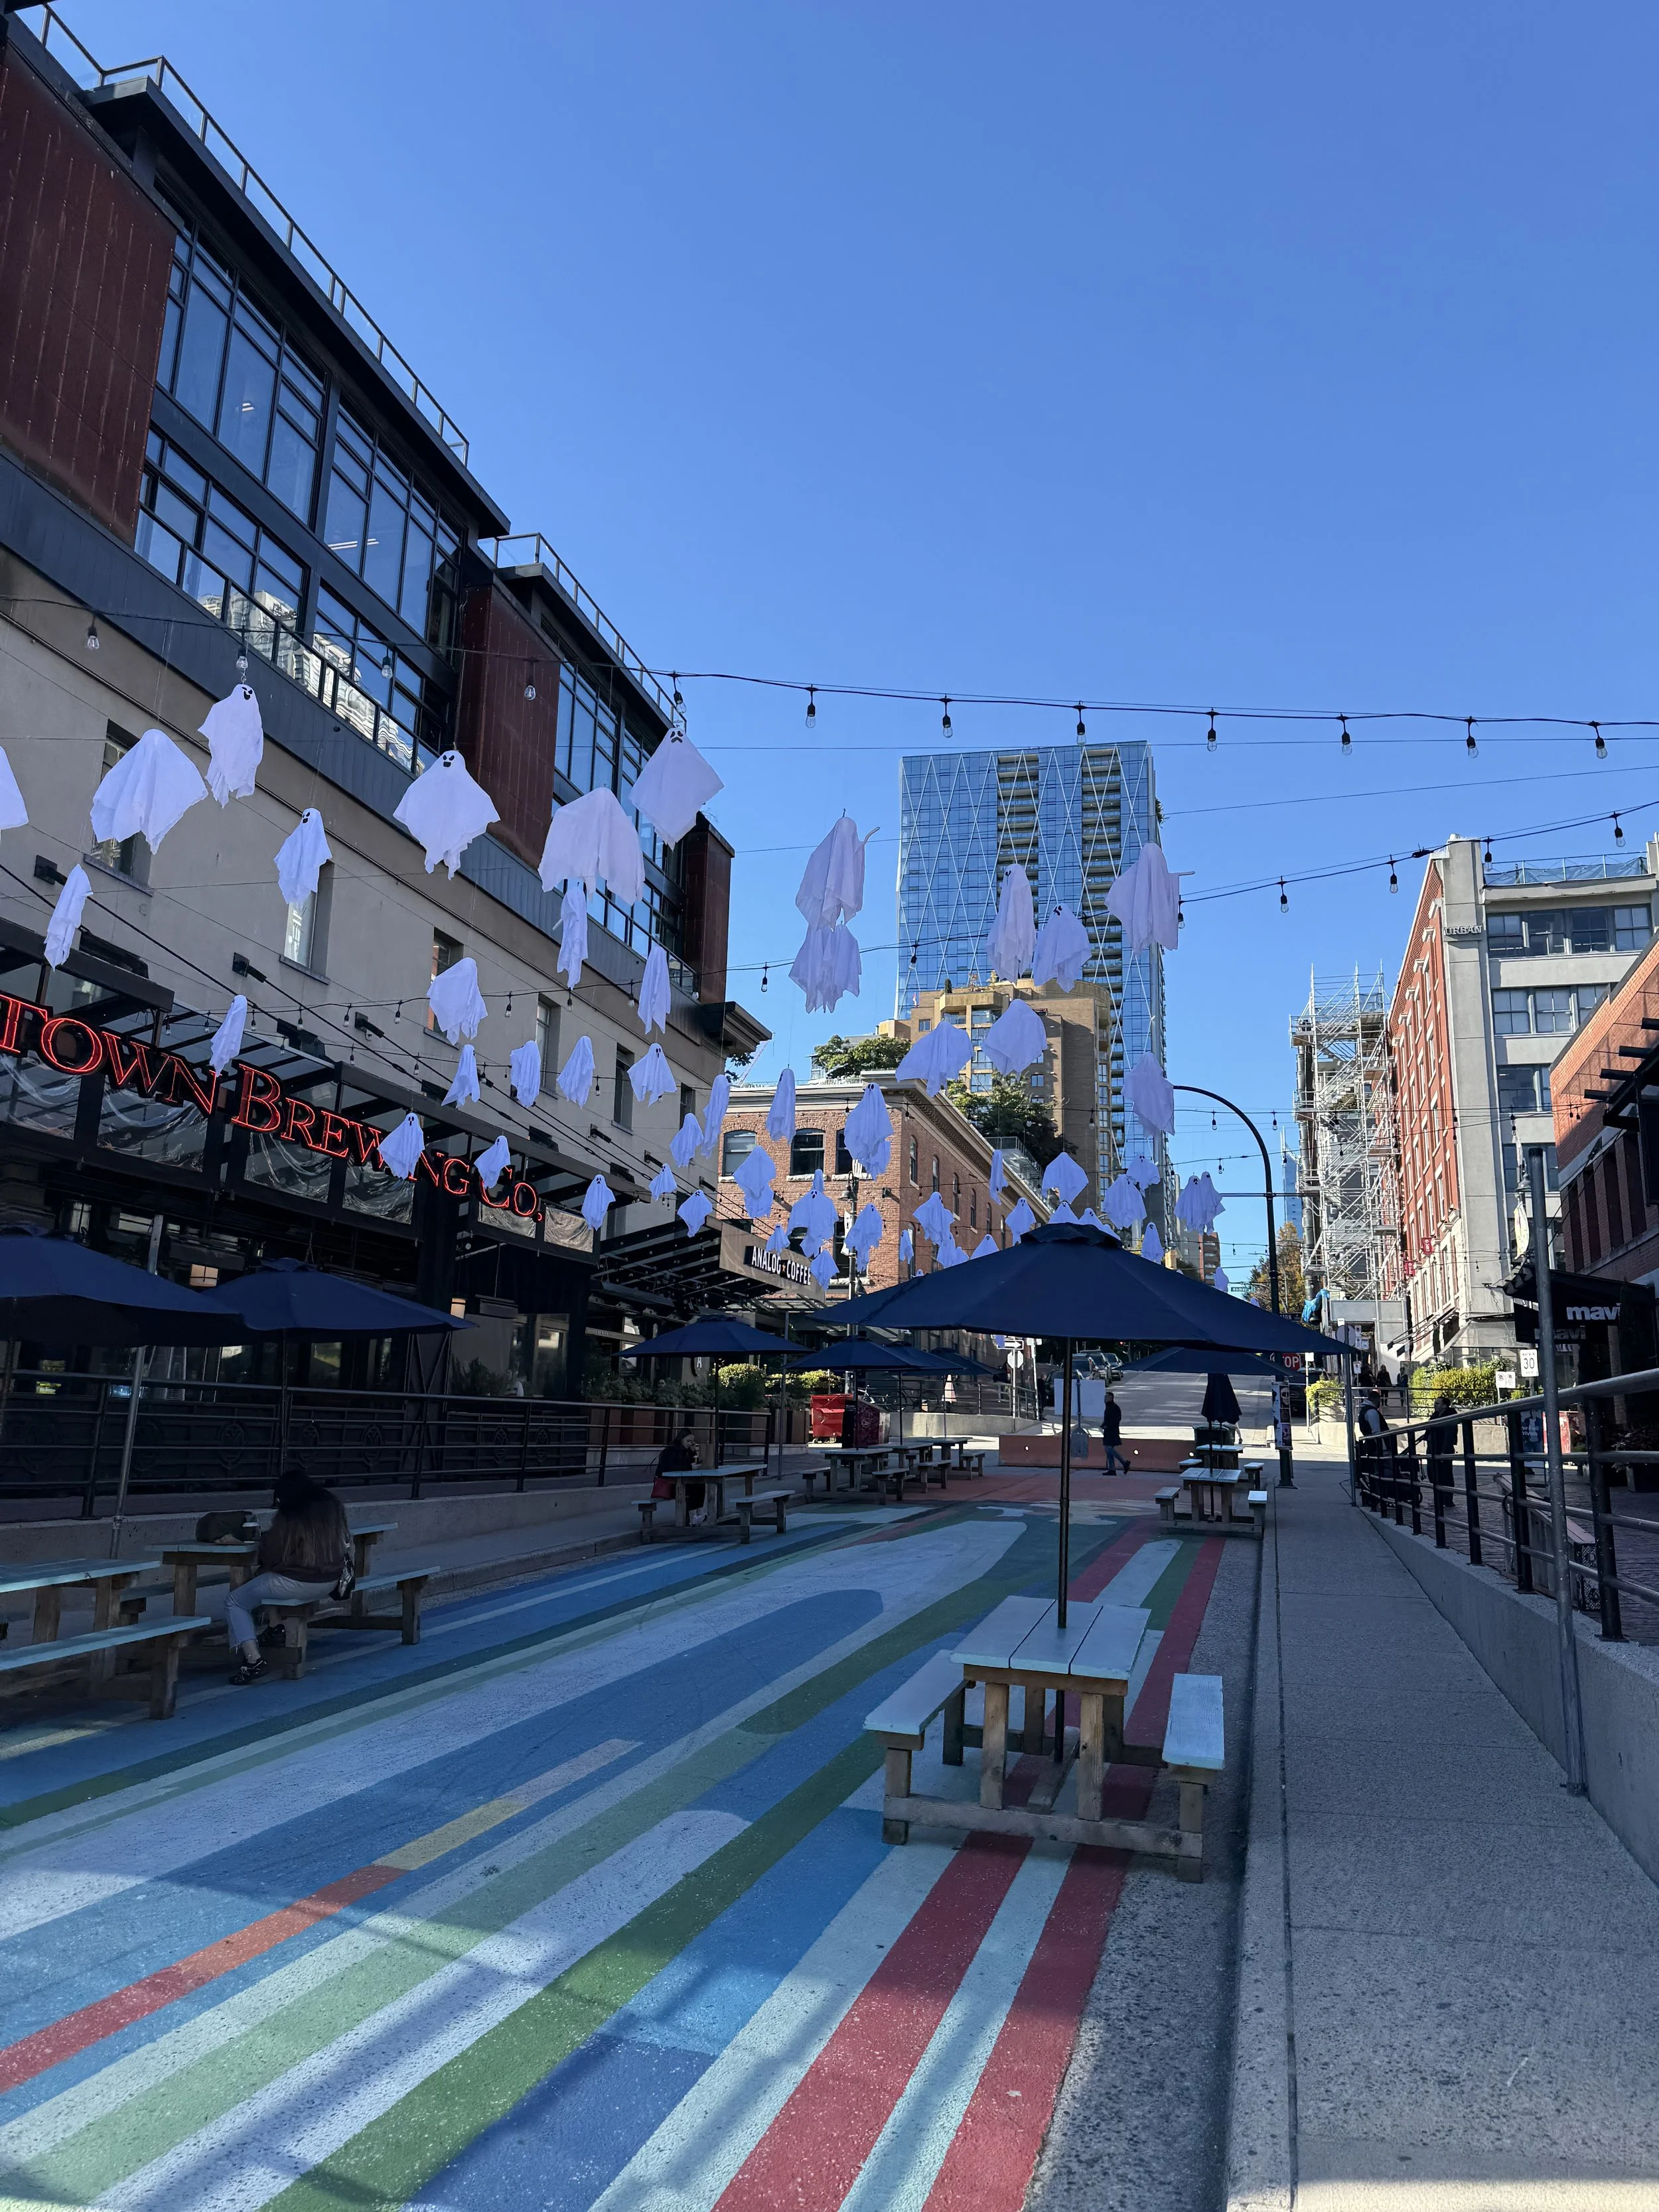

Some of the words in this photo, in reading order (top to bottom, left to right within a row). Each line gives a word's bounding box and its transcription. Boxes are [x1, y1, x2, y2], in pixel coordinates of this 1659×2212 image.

[1444, 925, 1482, 935] URBAN
[230, 1063, 470, 1195] BREWNG
[751, 1246, 781, 1275] ANALOG
[786, 1260, 811, 1286] COFFEE
[1524, 1358, 1535, 1369] 30
